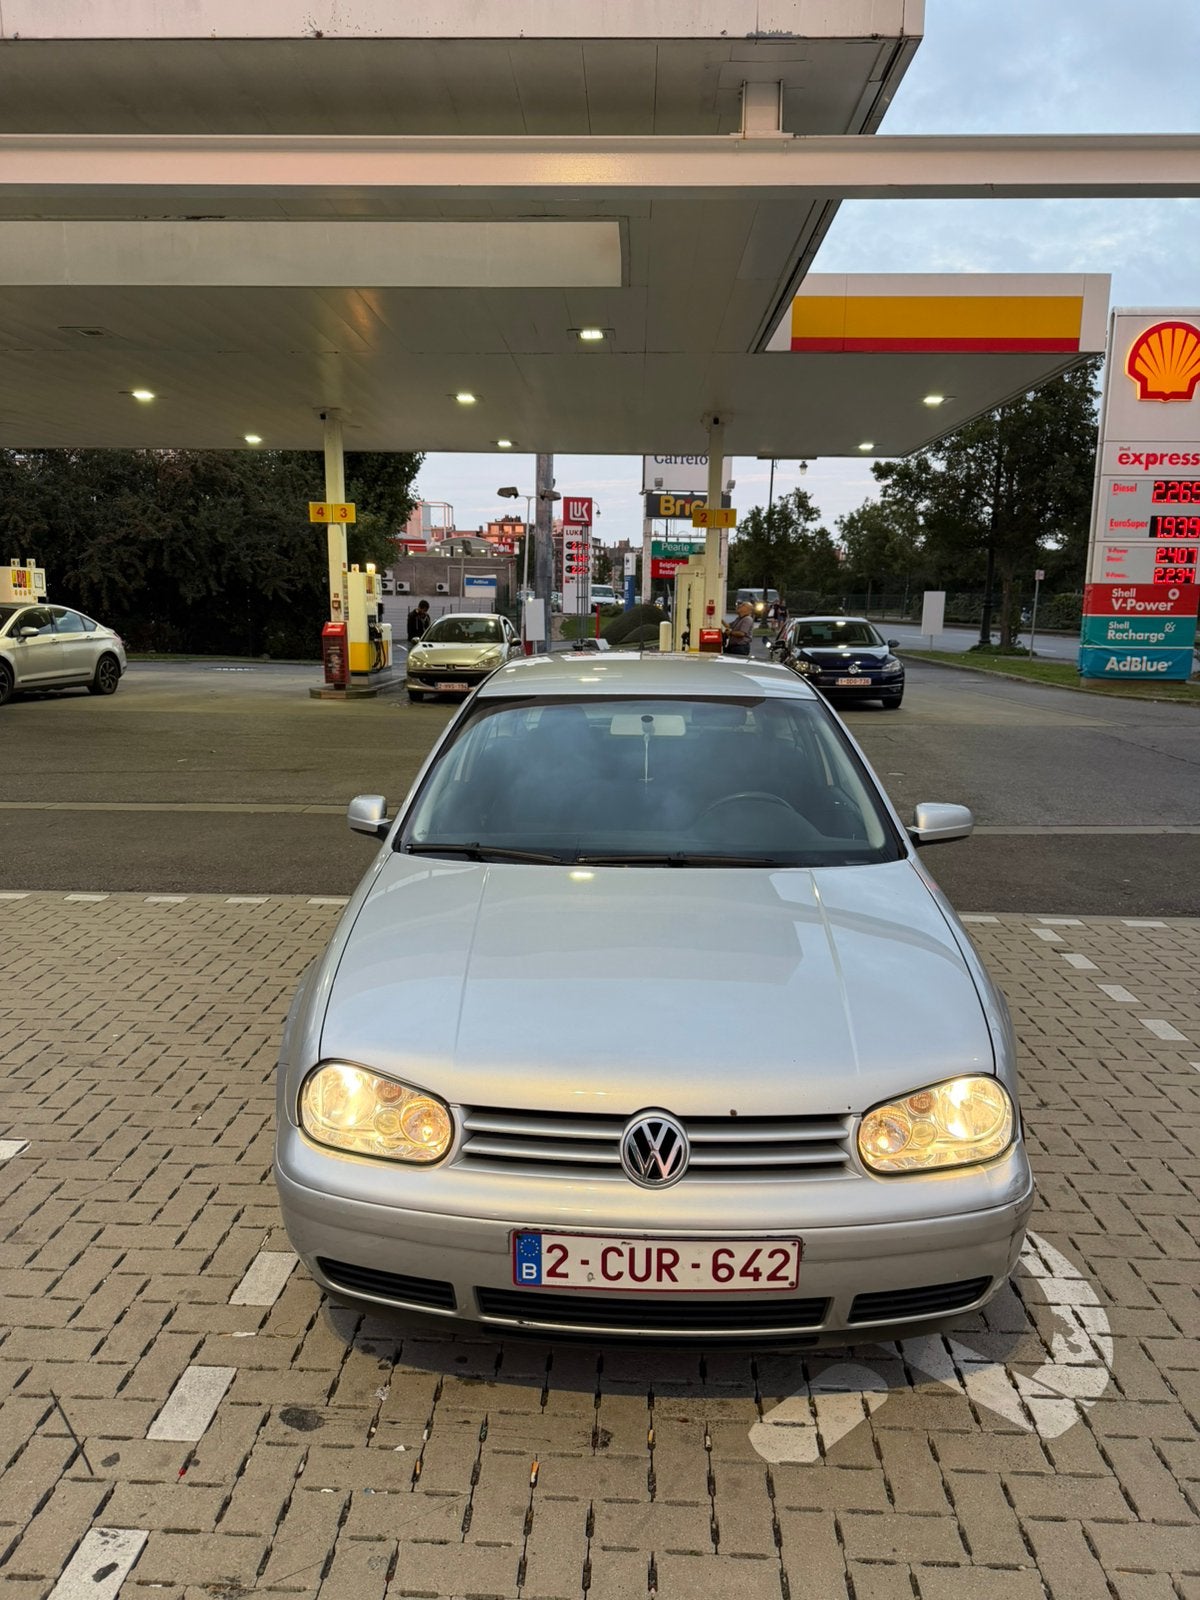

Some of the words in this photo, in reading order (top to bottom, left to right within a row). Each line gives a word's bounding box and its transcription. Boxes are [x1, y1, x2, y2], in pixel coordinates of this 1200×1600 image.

[654, 454, 709, 465] Carrefo
[1117, 452, 1200, 471] express
[1112, 483, 1137, 493] Diesel
[316, 506, 325, 517] 4
[340, 507, 348, 518] 3
[570, 501, 589, 521] LUK
[660, 495, 708, 516] Bric
[700, 512, 707, 523] 2
[724, 512, 729, 523] 1
[1109, 518, 1148, 529] EuroSuper
[1157, 516, 1200, 538] 1.939
[661, 542, 690, 552] Pearle
[1155, 547, 1197, 565] 2.407
[1153, 568, 1195, 584] 2.234
[1112, 588, 1136, 597] Shell
[1112, 599, 1174, 611] V-Power
[1108, 621, 1130, 630] Shell
[1107, 629, 1166, 643] Recharge
[1105, 656, 1169, 672] AdBlue
[522, 1263, 537, 1279] B
[546, 1244, 790, 1283] 2-CUR-642
